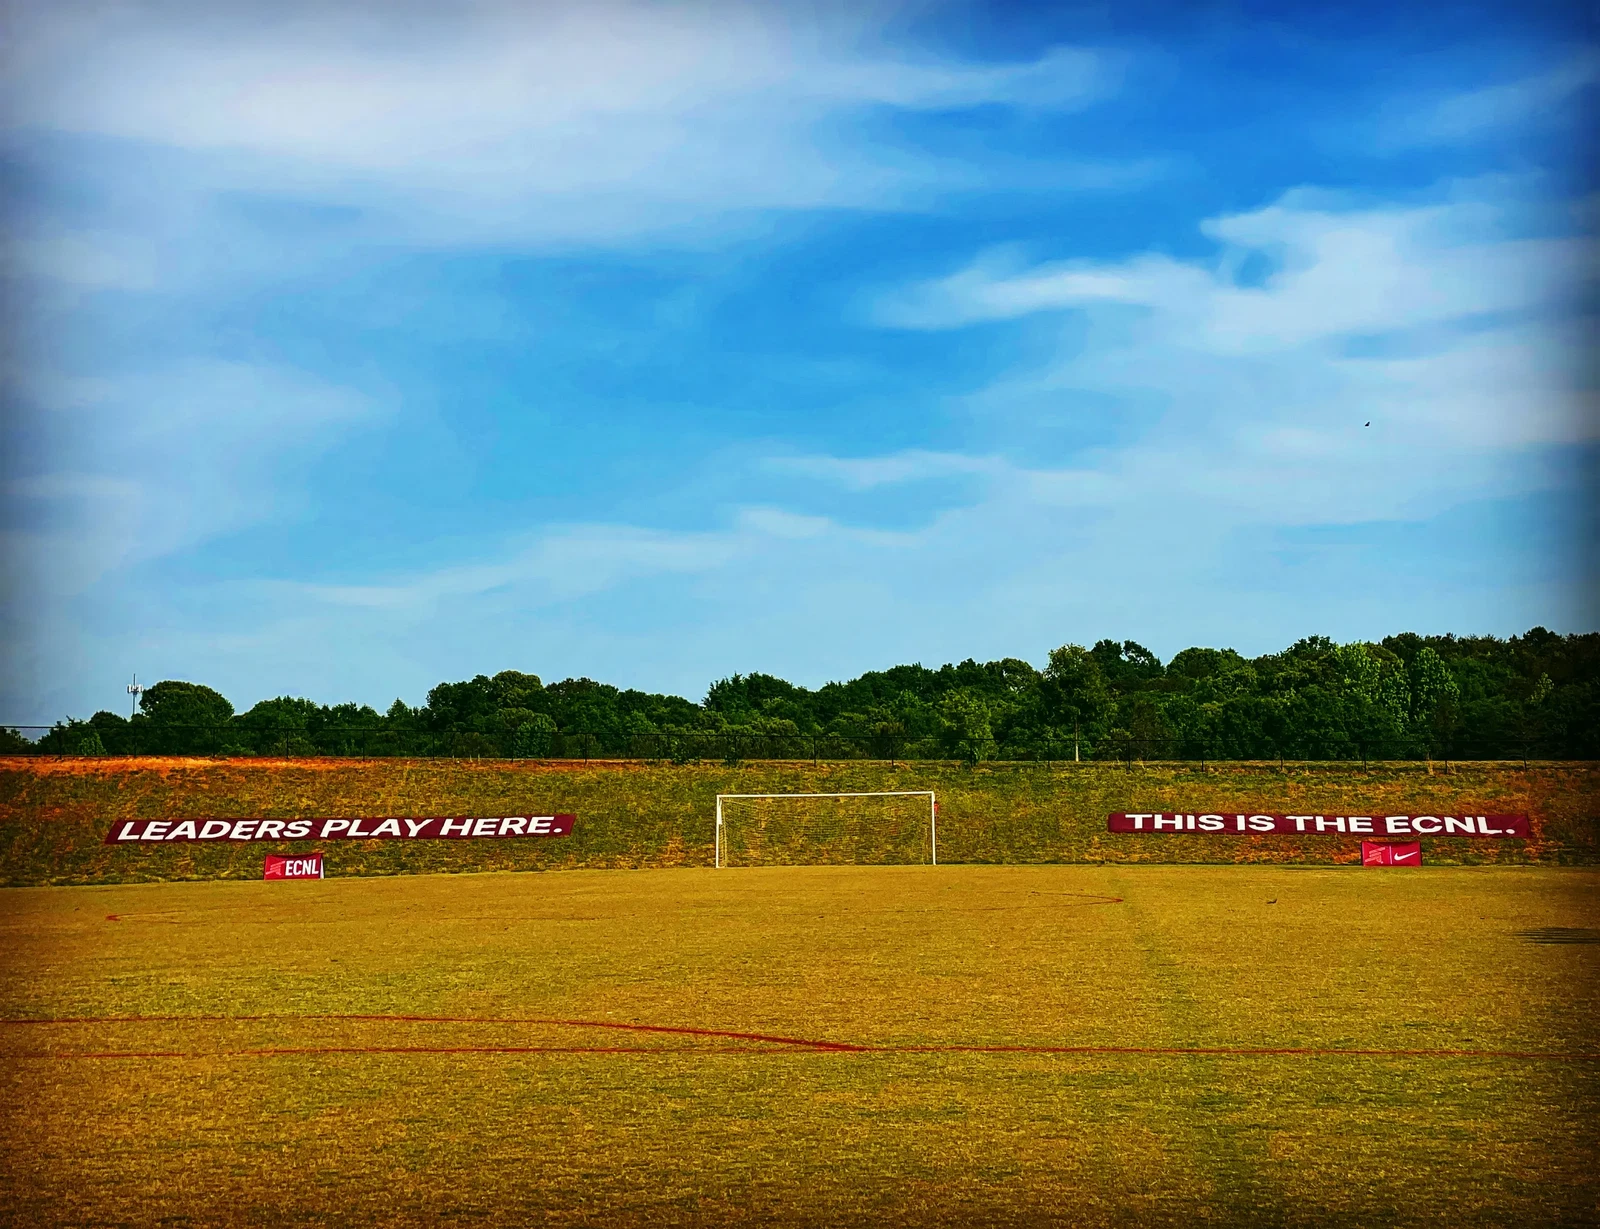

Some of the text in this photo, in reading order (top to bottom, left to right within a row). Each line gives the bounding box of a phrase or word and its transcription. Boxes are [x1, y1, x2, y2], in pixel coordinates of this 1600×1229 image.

[117, 816, 563, 841] LEADERS PLAY HERE.
[1125, 814, 1516, 835] THIS IS THE ECNL.
[285, 859, 319, 876] ECNL
